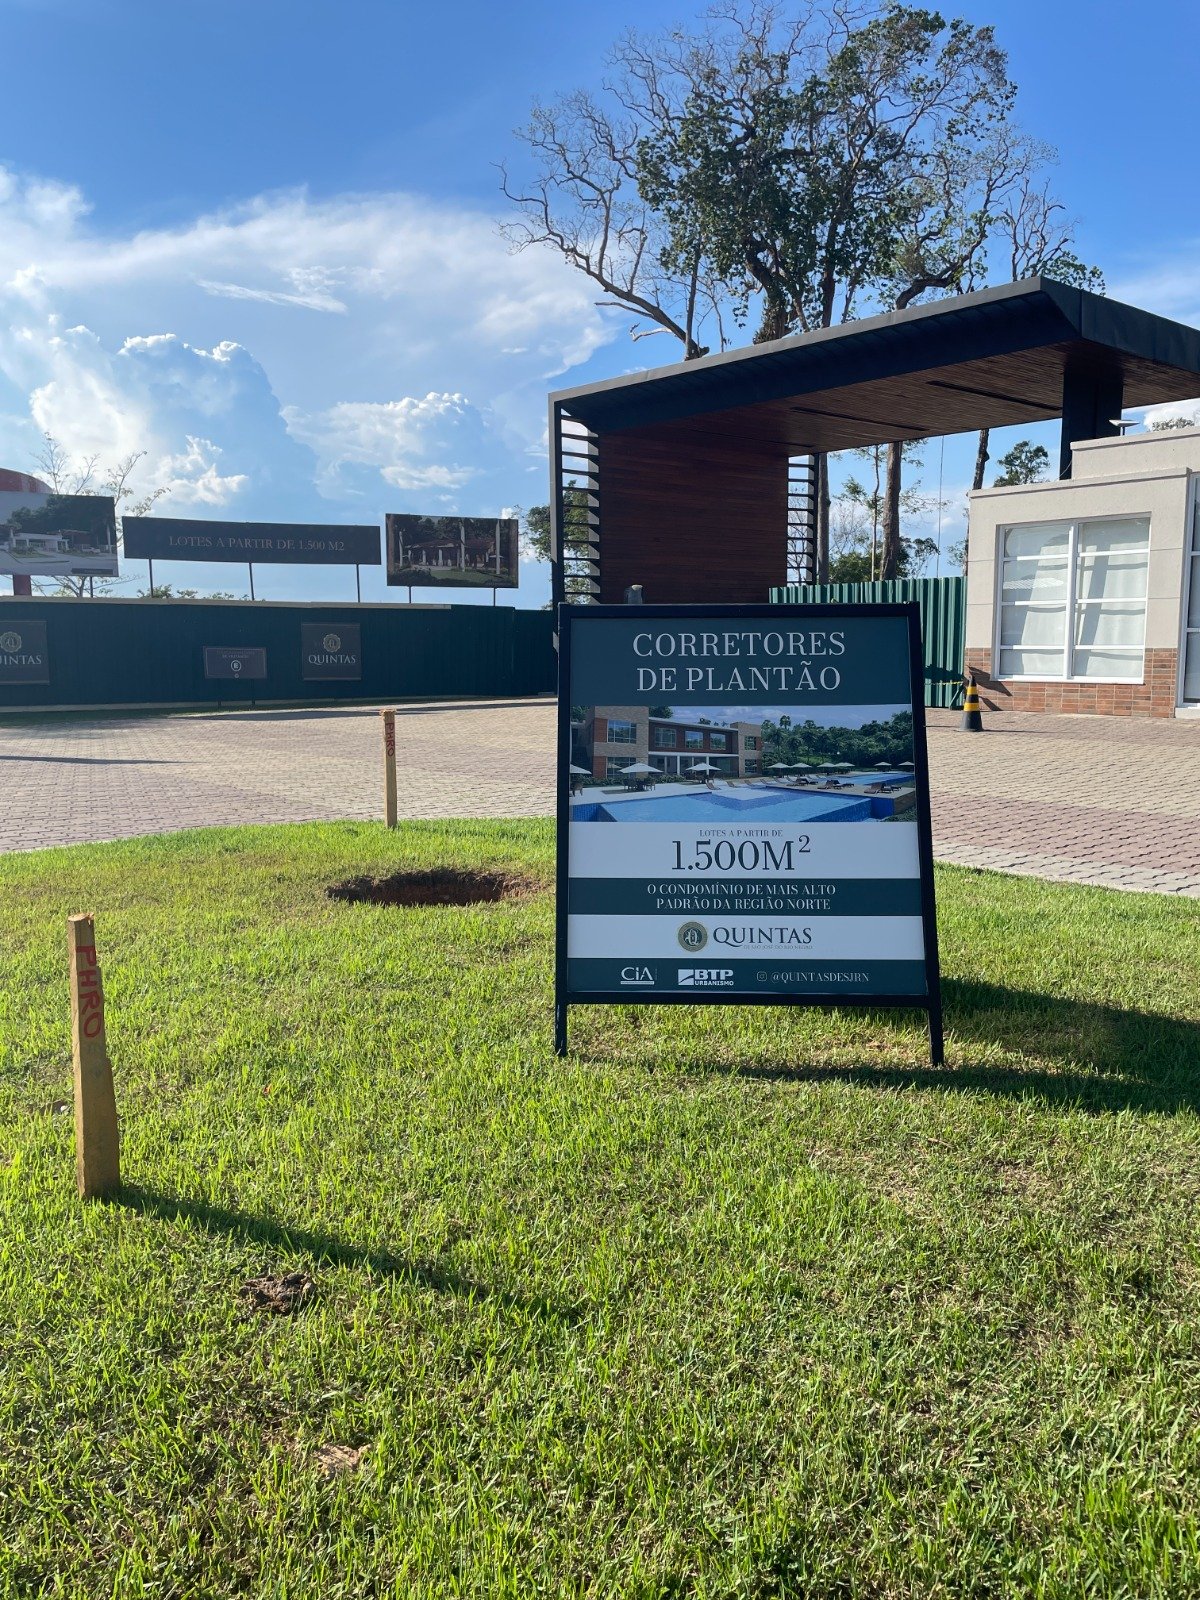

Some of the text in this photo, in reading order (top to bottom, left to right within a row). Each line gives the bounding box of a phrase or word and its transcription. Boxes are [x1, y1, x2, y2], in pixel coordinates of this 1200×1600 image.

[169, 535, 345, 551] LOTES A PARTIR DE 1.500 M2
[632, 632, 846, 657] CORRETORES
[0, 655, 42, 665] INTAS
[308, 654, 357, 666] QUINTAS
[636, 660, 841, 691] DE PLANTÃO
[699, 829, 784, 837] LOTES A PARTIR DE
[647, 881, 836, 895] O CONDOMÍNIO DE MAIS ALTO
[656, 896, 831, 910] PADRÃO DA REGIÃO NORTE
[712, 927, 812, 947] QUINTAS
[694, 969, 734, 980] BTP
[771, 971, 869, 983] @QUINTASDESJRN
[75, 945, 102, 1038] PHRO
